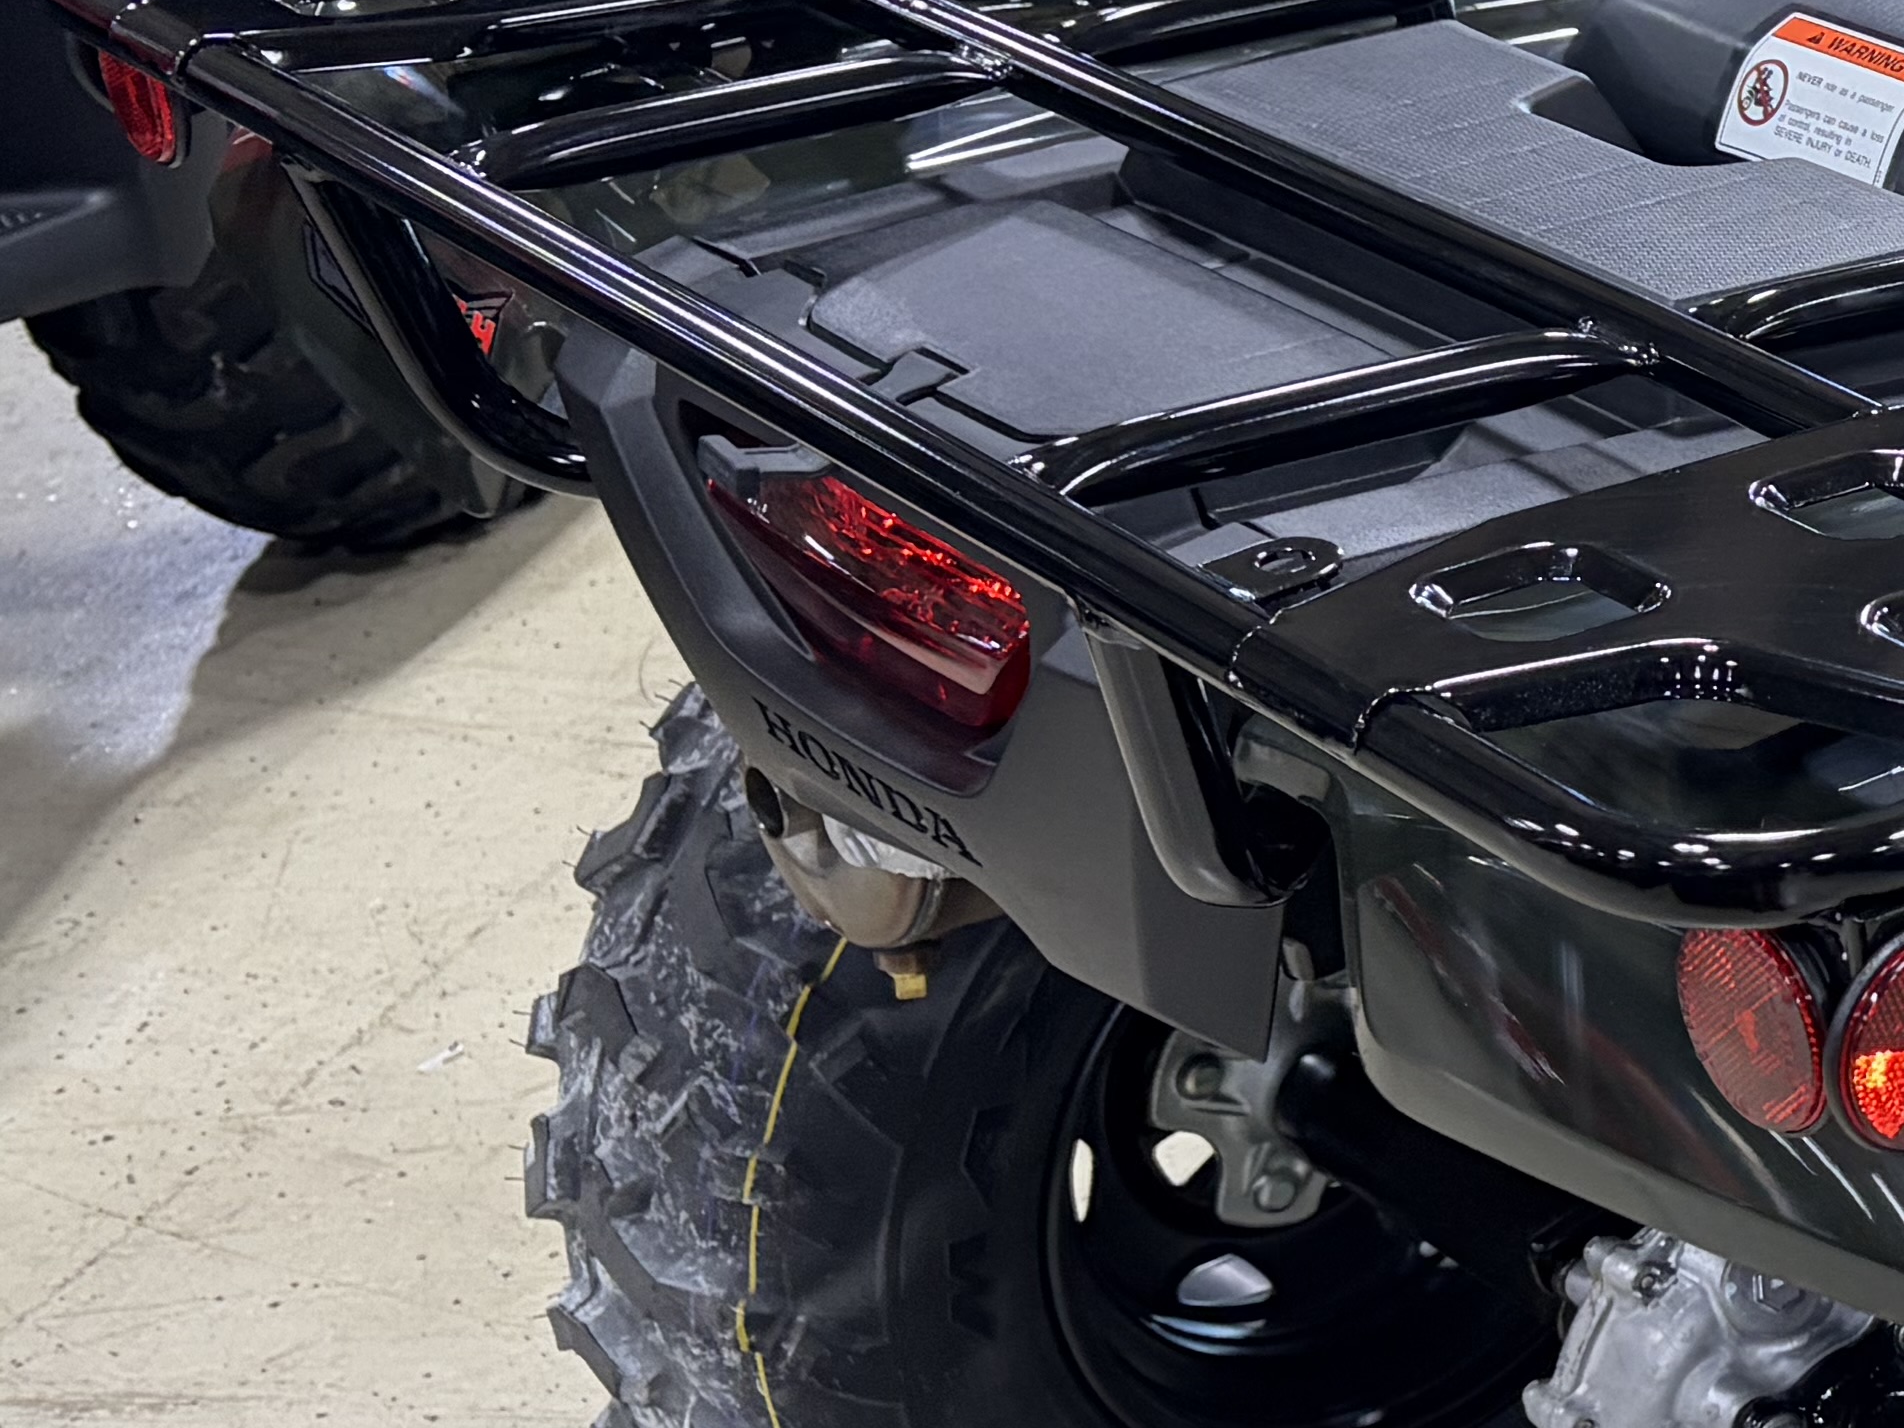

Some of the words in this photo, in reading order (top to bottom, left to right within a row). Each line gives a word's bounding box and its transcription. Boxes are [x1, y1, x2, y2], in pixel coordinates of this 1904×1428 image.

[1795, 71, 1823, 88] NEVER
[1805, 136, 1834, 155] INJURY
[752, 696, 983, 868] HONDA
